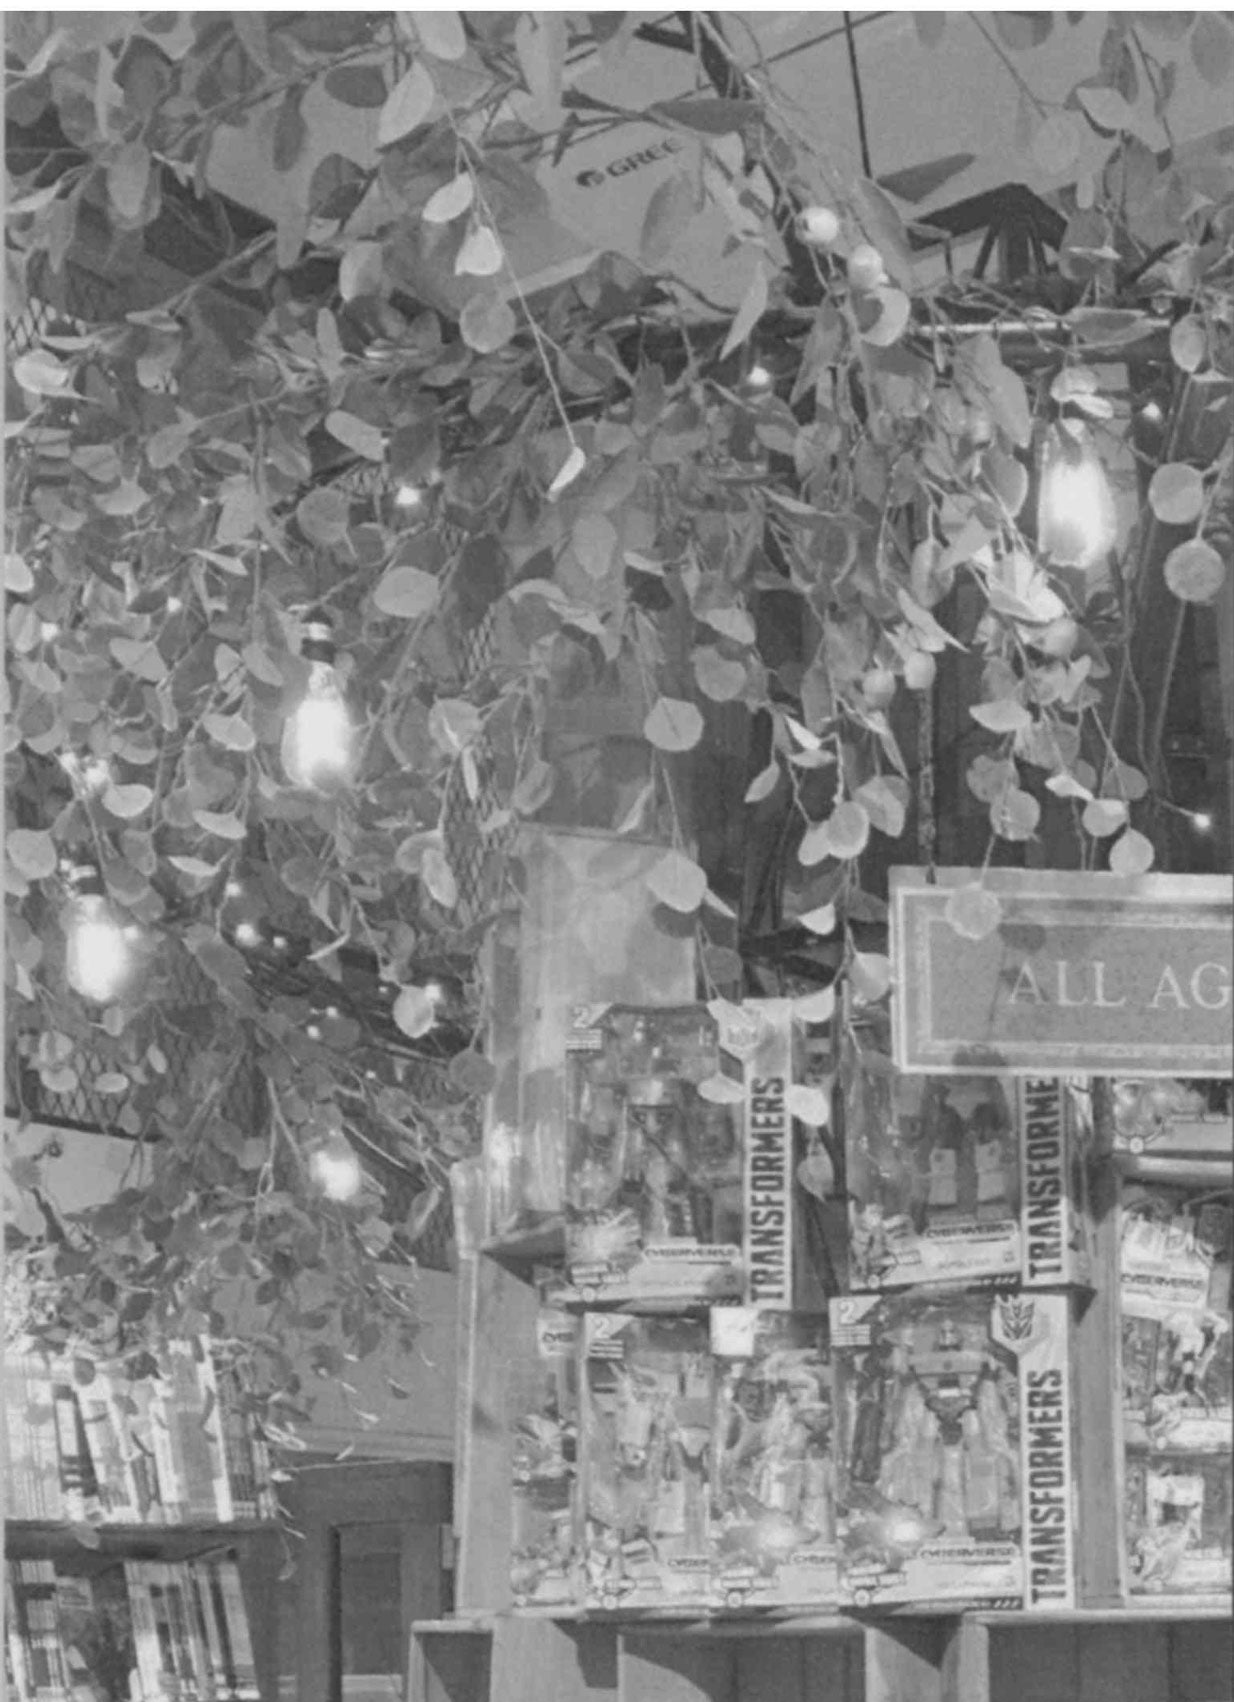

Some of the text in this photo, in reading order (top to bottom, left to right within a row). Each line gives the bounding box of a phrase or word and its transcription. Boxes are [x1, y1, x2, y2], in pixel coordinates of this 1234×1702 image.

[606, 137, 685, 177] GREE
[1008, 960, 1233, 1010] ALL AG
[750, 1076, 785, 1303] TRANSFORMERS
[1026, 1076, 1063, 1279] TRANSFORME
[838, 1302, 856, 1325] 2
[1026, 1369, 1067, 1604] TRANSFORMERS
